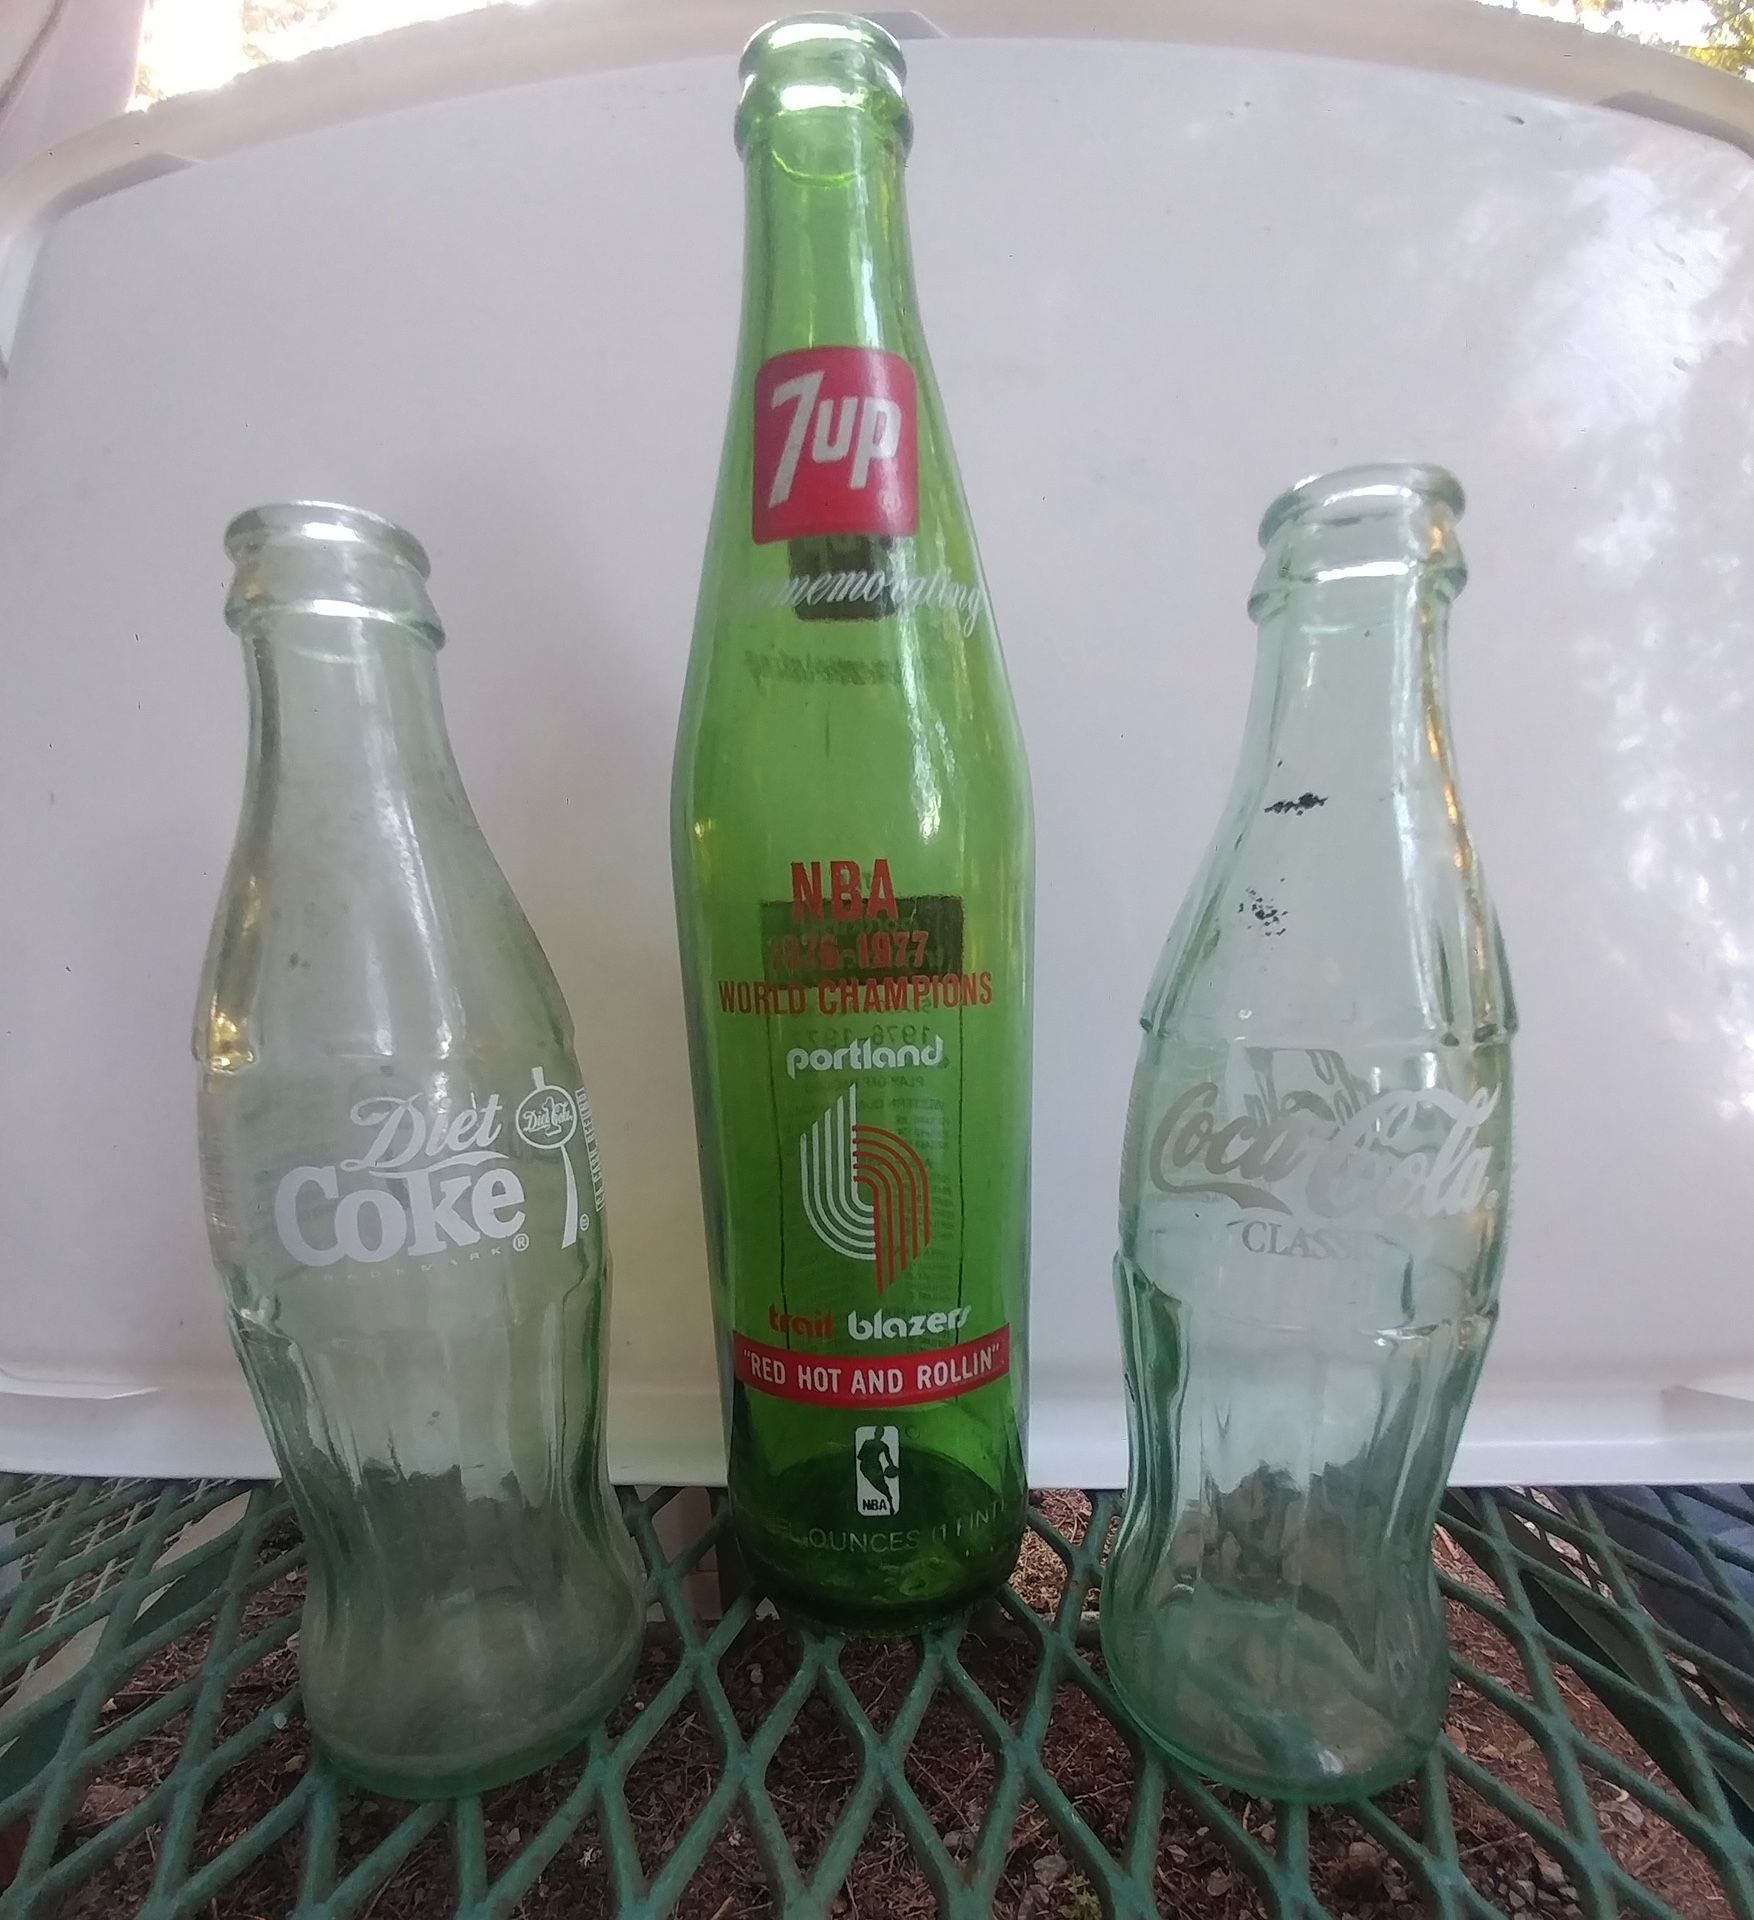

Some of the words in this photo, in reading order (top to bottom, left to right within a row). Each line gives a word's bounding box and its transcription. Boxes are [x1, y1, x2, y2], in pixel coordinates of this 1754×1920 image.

[790, 859, 899, 922] NBA
[719, 979, 807, 1015] WORLD
[818, 971, 993, 1015] CHAMPIONS
[786, 1034, 943, 1080] portland
[341, 1092, 503, 1172] Diet
[274, 1165, 527, 1267] Coke
[847, 1304, 973, 1341] blazers
[797, 1364, 842, 1393] HOT
[850, 1368, 904, 1395] AND
[862, 1498, 888, 1512] NBA
[808, 1527, 922, 1552] OUNCES
